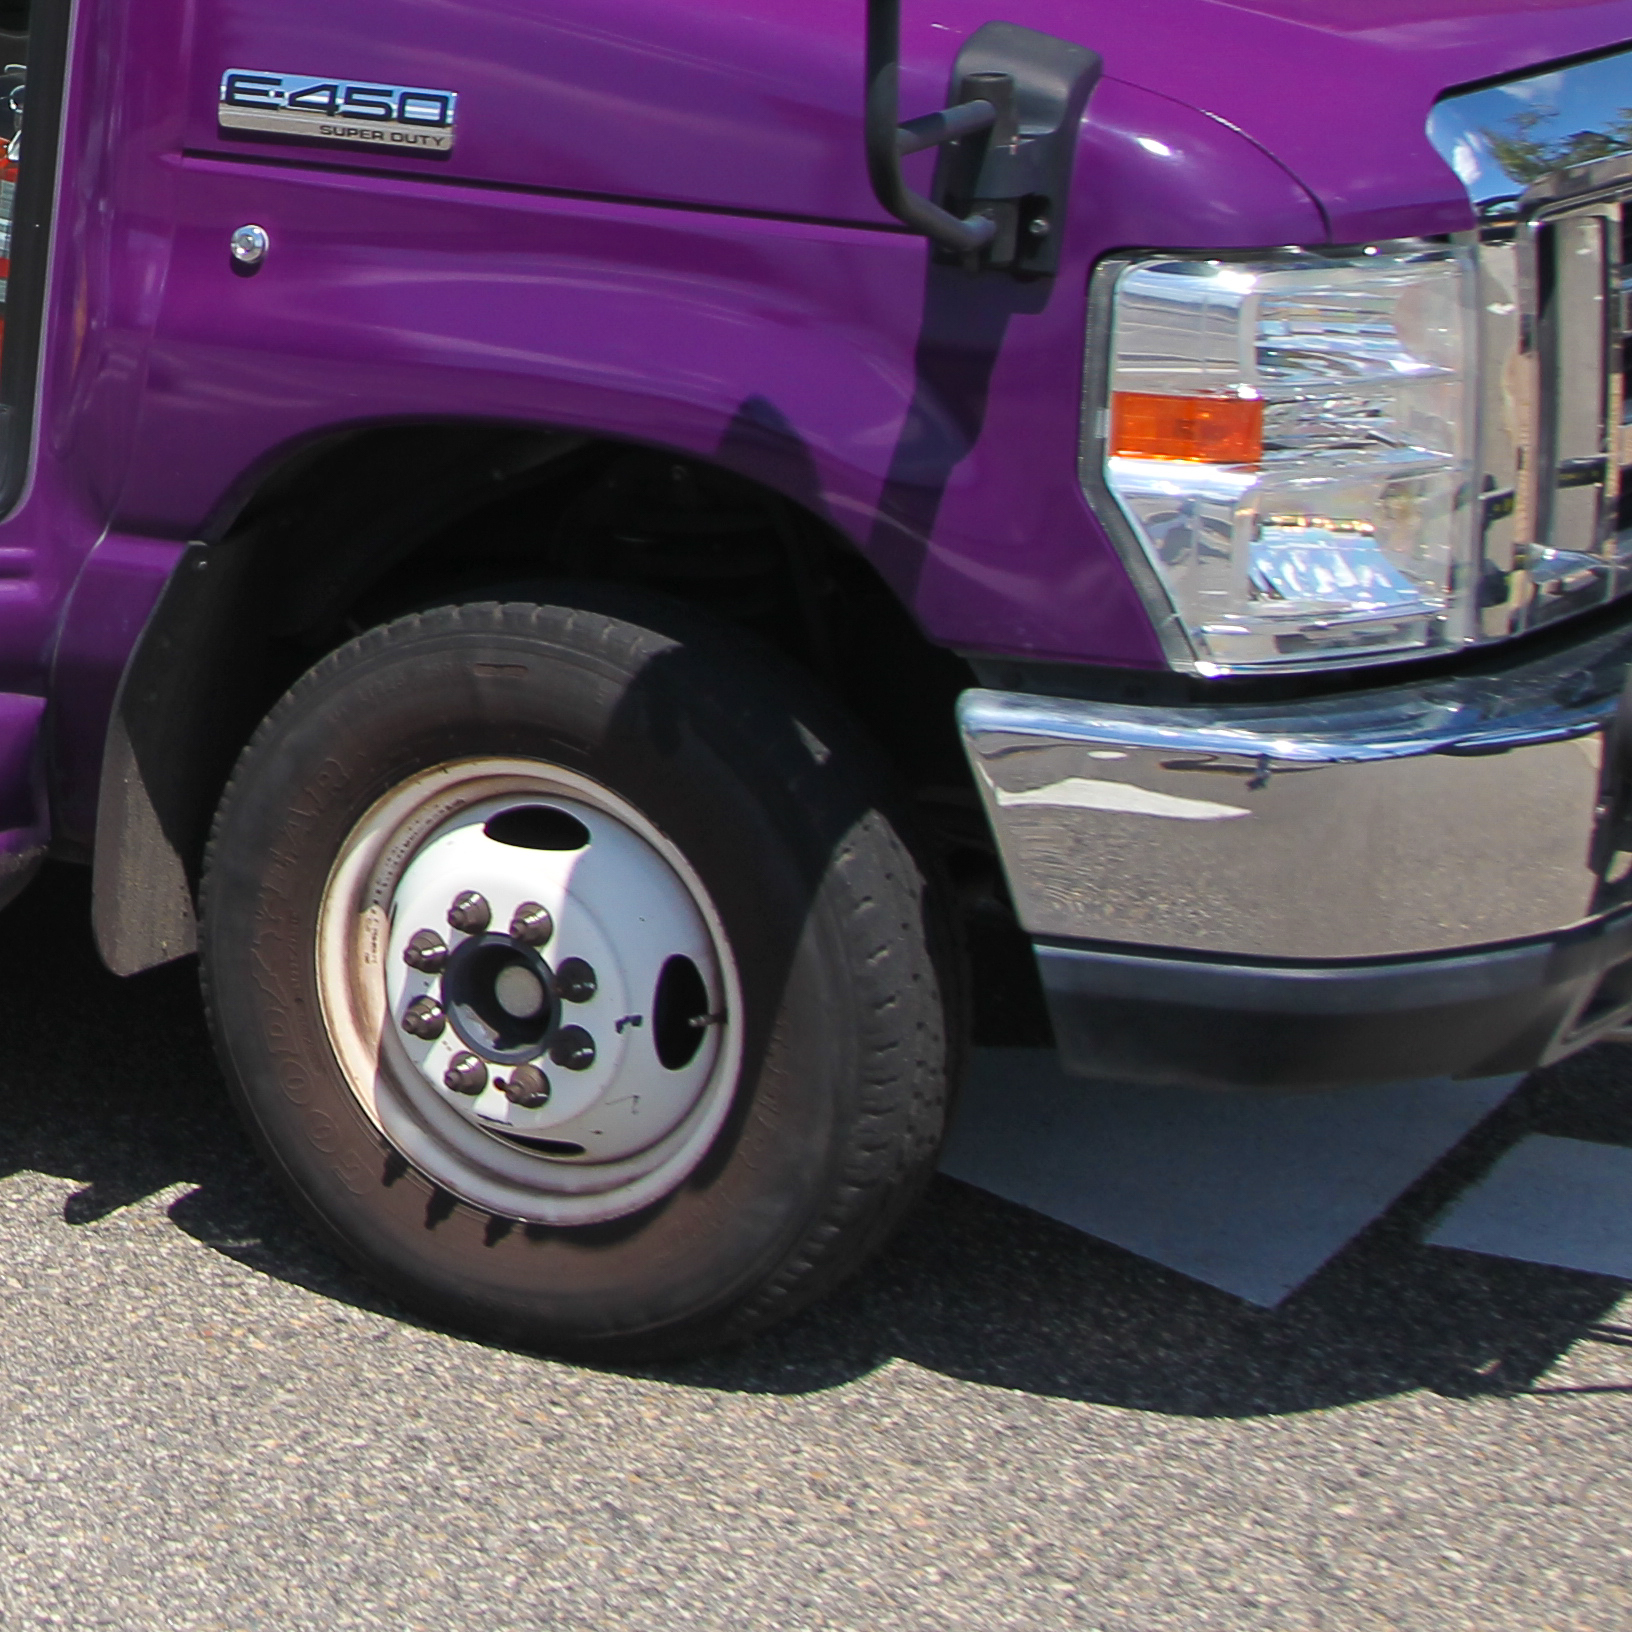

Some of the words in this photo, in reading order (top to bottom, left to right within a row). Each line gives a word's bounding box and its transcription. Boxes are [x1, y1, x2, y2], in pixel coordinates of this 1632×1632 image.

[225, 71, 453, 128] E-450
[319, 124, 385, 141] SUPER
[390, 131, 445, 147] DUTY
